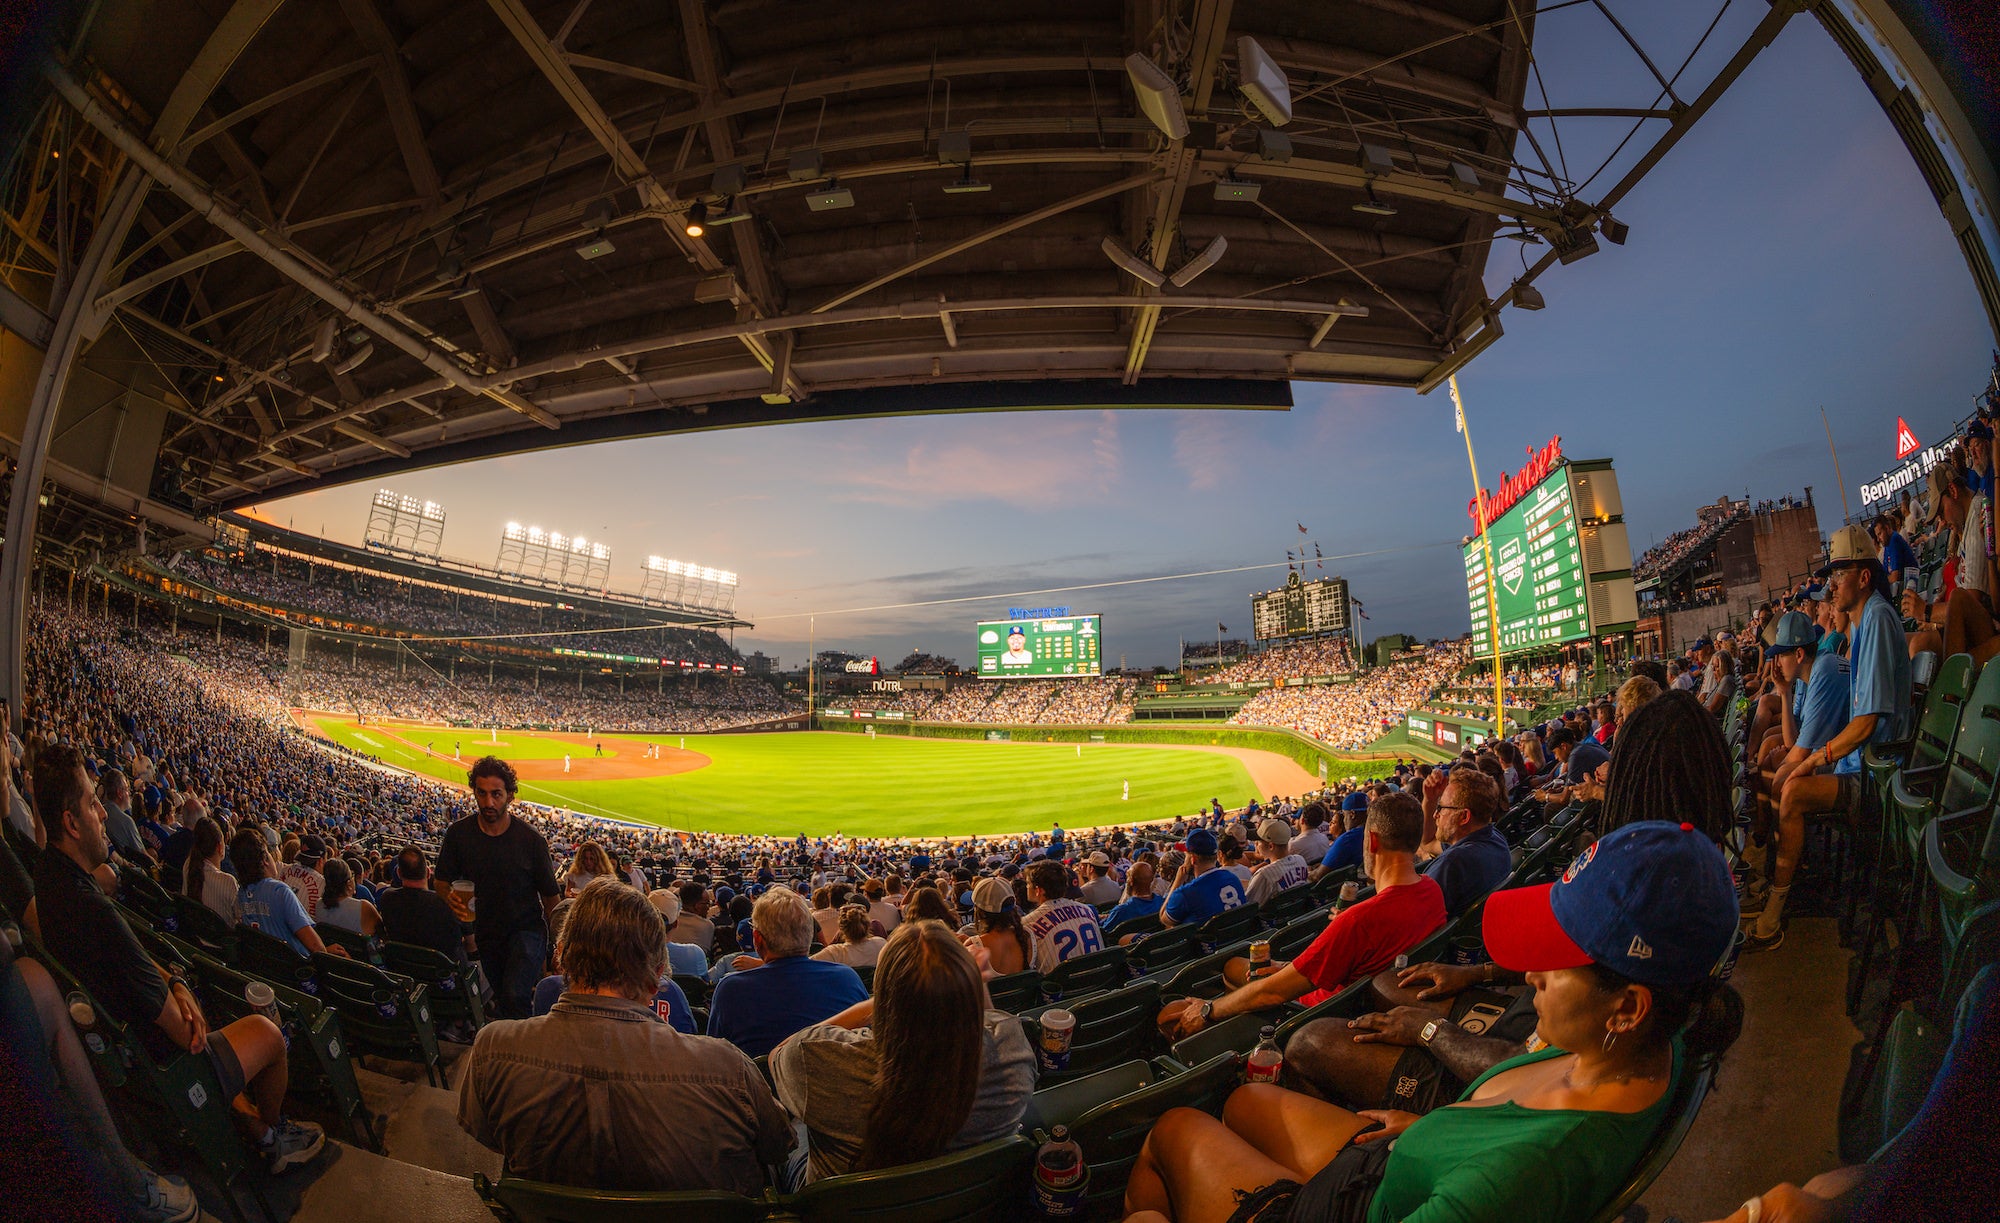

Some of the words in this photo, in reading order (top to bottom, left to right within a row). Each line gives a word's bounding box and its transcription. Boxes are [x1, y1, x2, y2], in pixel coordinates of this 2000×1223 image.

[1860, 460, 1921, 506] Benjamin
[1921, 438, 1960, 474] Moor
[1468, 434, 1562, 537] Budweiser
[1008, 606, 1071, 620] WINTRUST
[845, 660, 873, 673] Coca-Cola
[1219, 886, 1242, 911] 8
[1053, 923, 1101, 962] 28
[191, 1086, 204, 1104] 14
